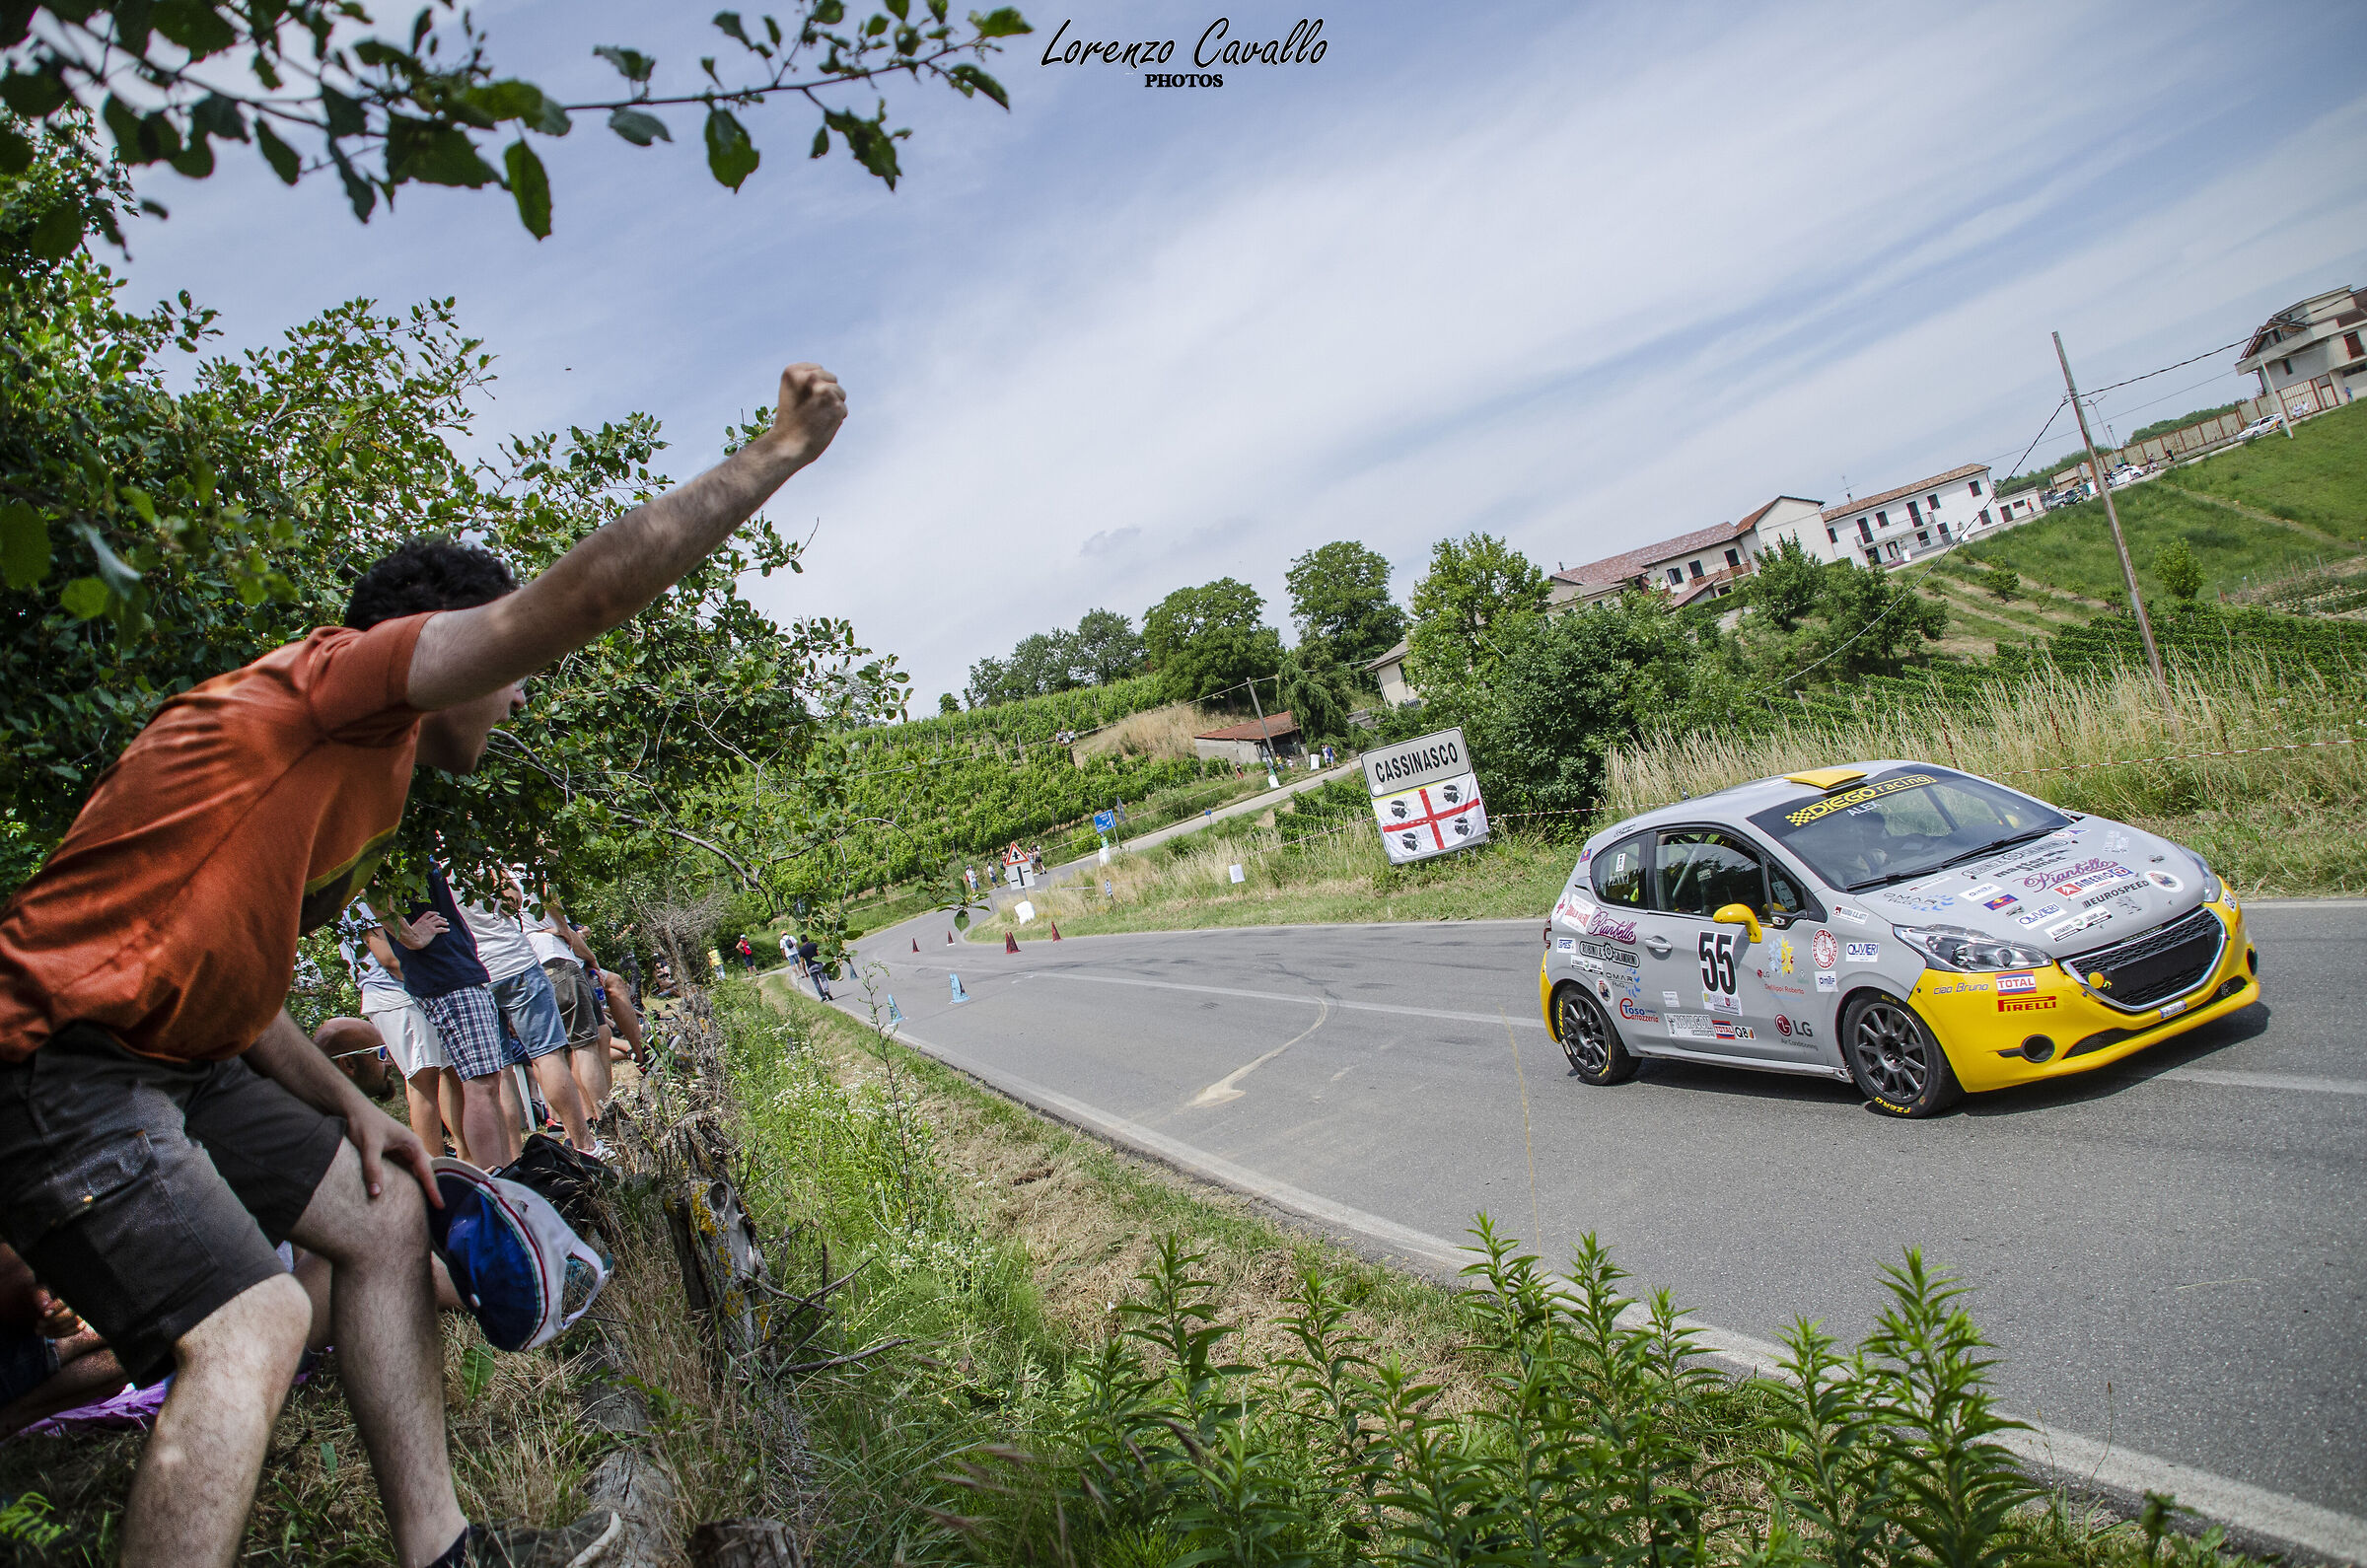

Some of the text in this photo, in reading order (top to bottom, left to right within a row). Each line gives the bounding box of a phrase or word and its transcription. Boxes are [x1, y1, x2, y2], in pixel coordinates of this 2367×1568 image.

[1375, 742, 1458, 783] CASSINASCO
[1810, 776, 1928, 817] DIEGO racing
[1846, 800, 1882, 817] ALEX
[2015, 858, 2118, 892] Pianbello
[2074, 872, 2115, 889] AMERIO
[2089, 880, 2150, 905] EUROSPEED
[1588, 907, 1637, 945] Pianbello
[1698, 932, 1737, 995] 55
[1606, 971, 1634, 982] OMAR
[1998, 977, 2035, 989] TOTAL
[1933, 982, 1988, 995] ciao Bruno
[1622, 1004, 1646, 1017] Toso
[1997, 995, 2057, 1013] PIRELLI
[1715, 1026, 1734, 1034] TOTAL
[1736, 1027, 1749, 1038] Q8
[1792, 1020, 1814, 1037] LG
